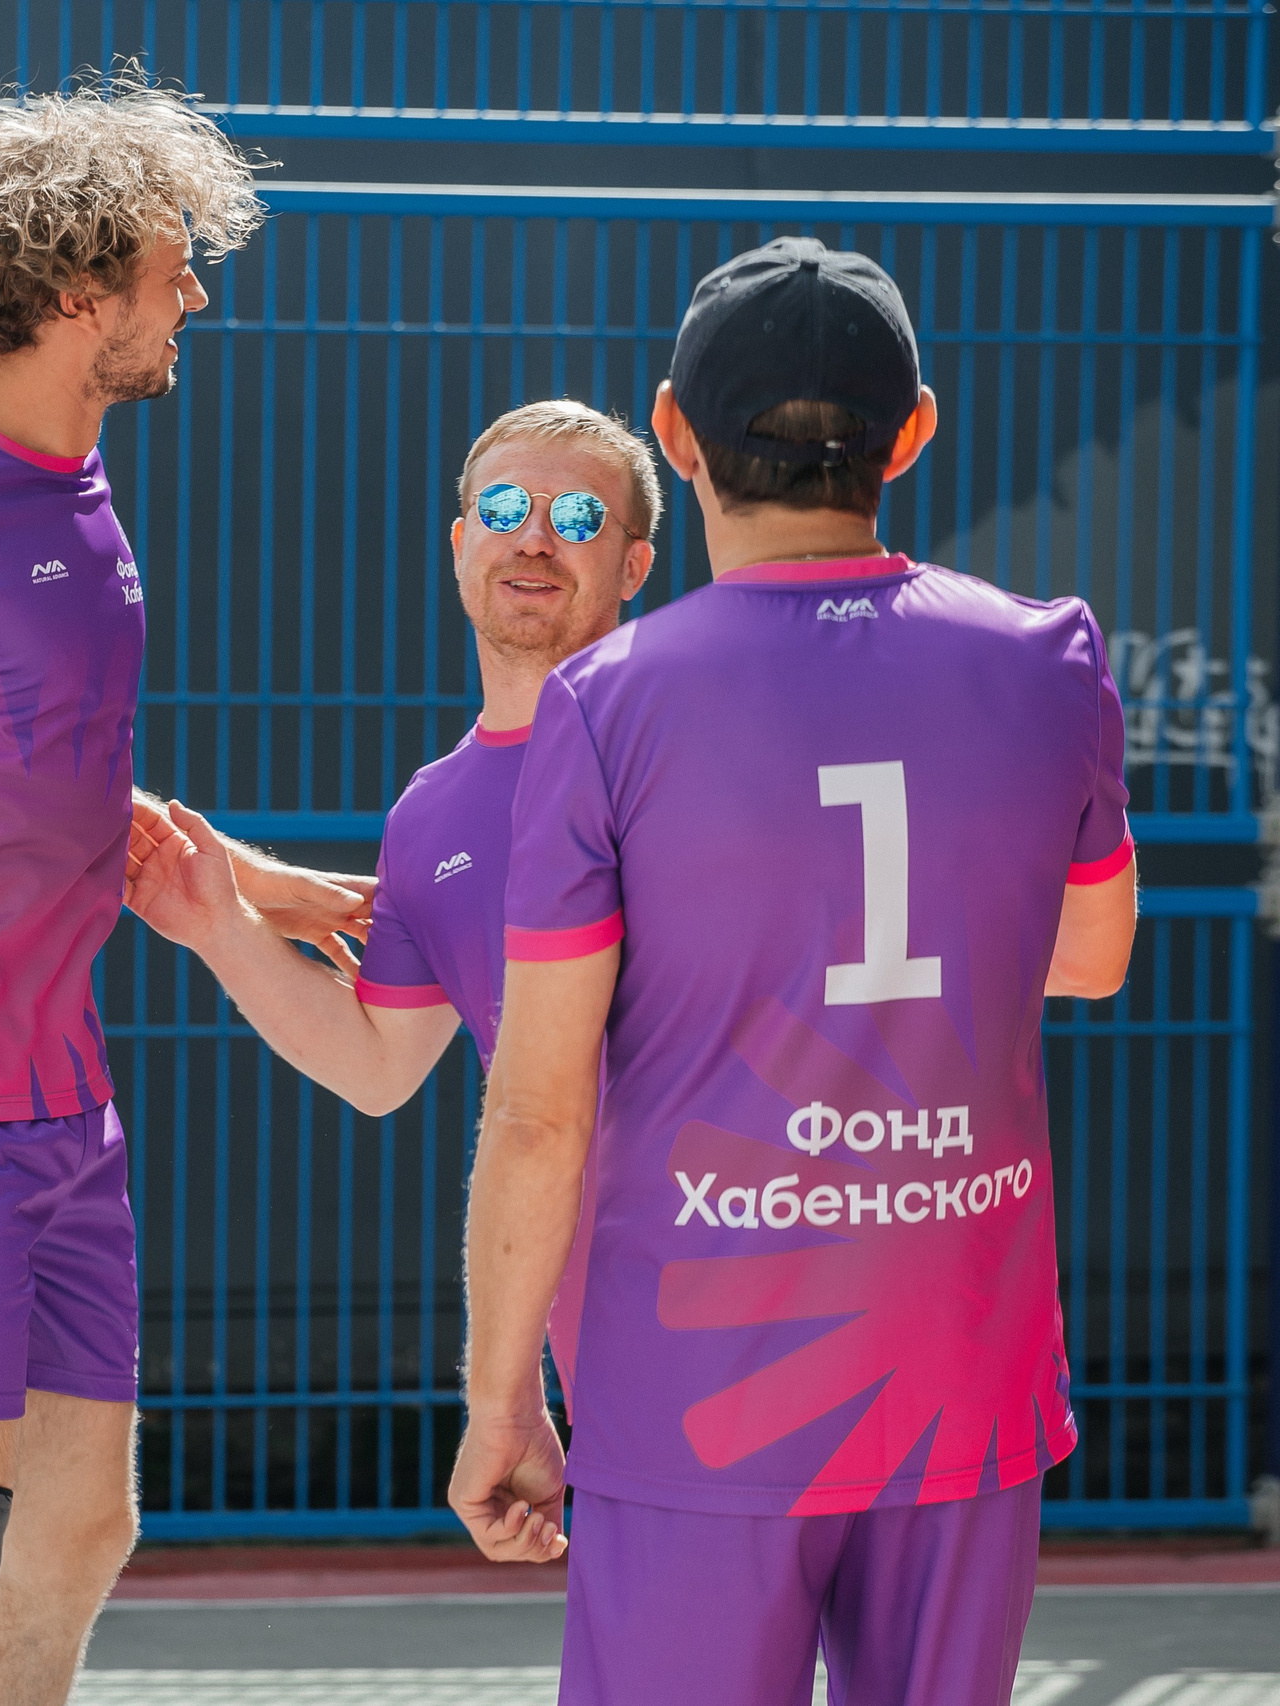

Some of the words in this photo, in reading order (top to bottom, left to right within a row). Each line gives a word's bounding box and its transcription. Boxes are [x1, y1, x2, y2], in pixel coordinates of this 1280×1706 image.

[817, 760, 942, 1005] 1
[786, 1101, 974, 1159] Фонд
[674, 1158, 1033, 1230] Хабенского
